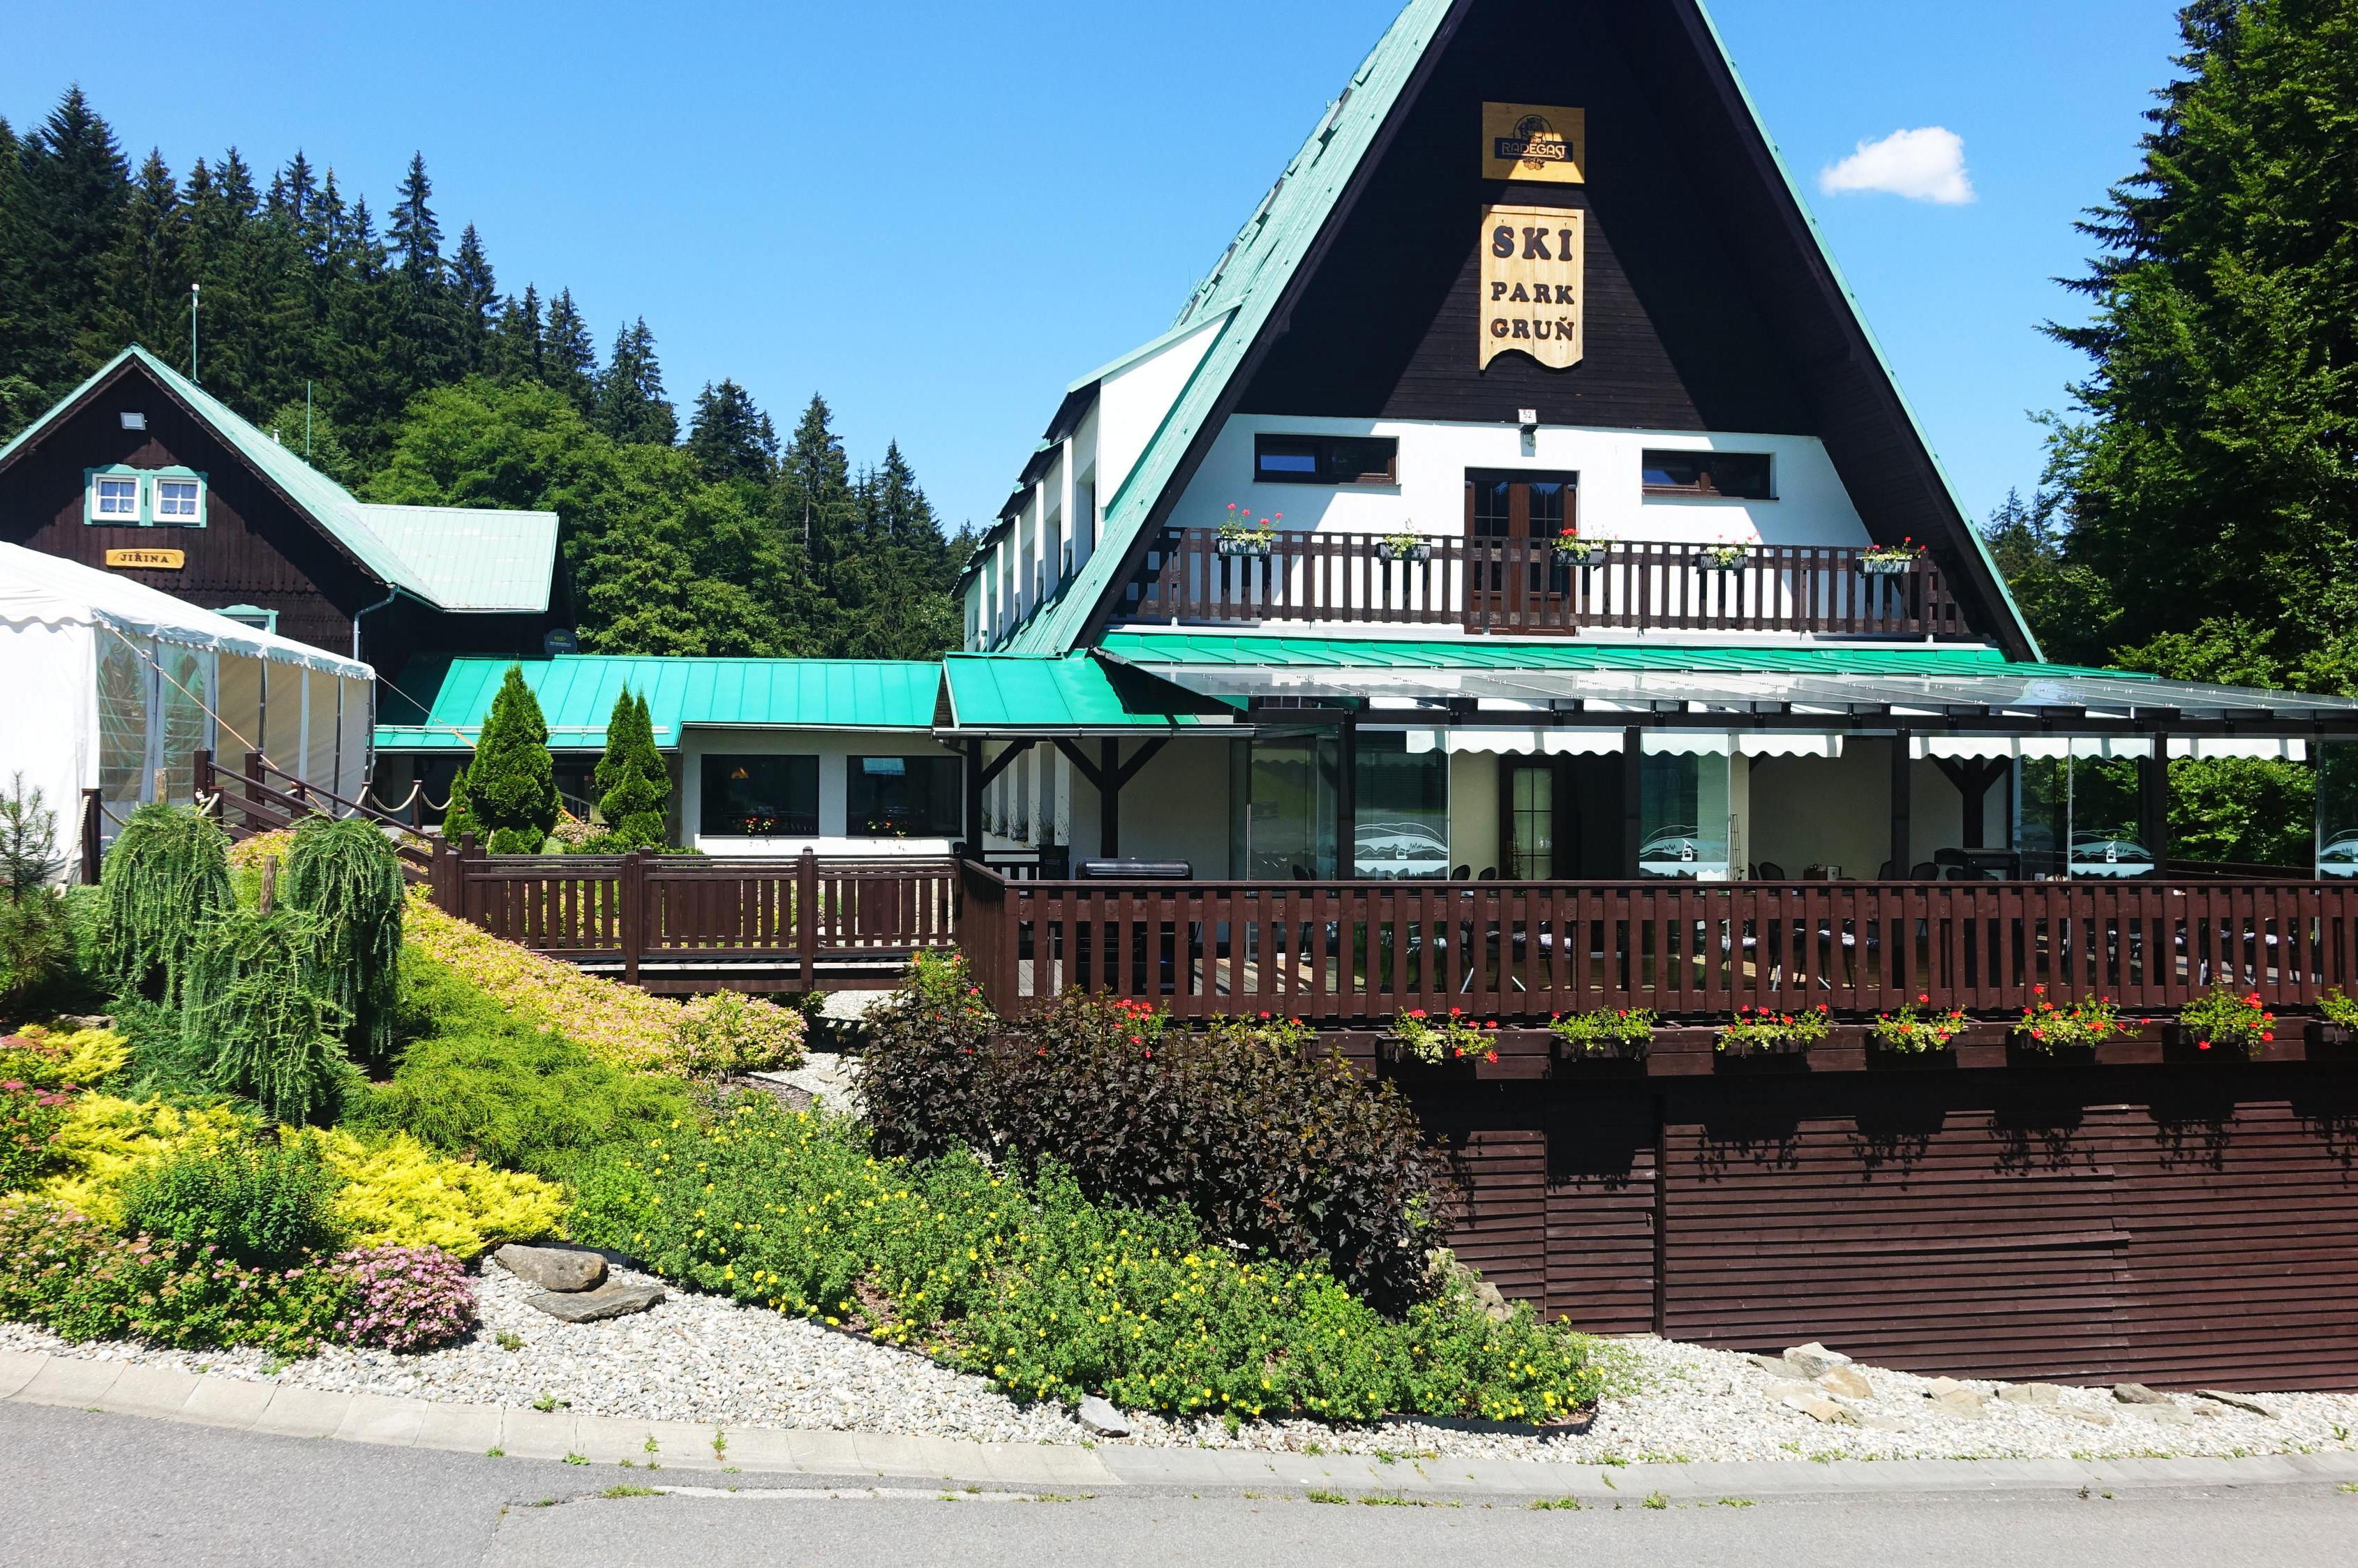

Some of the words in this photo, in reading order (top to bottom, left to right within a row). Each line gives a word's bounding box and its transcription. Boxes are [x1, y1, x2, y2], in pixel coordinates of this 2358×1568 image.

[1502, 142, 1567, 159] RADEGAST
[1492, 225, 1573, 262] SKI
[1491, 281, 1574, 304] PARK
[1491, 316, 1574, 341] GRUŇ
[120, 552, 169, 563] JIŘINA
